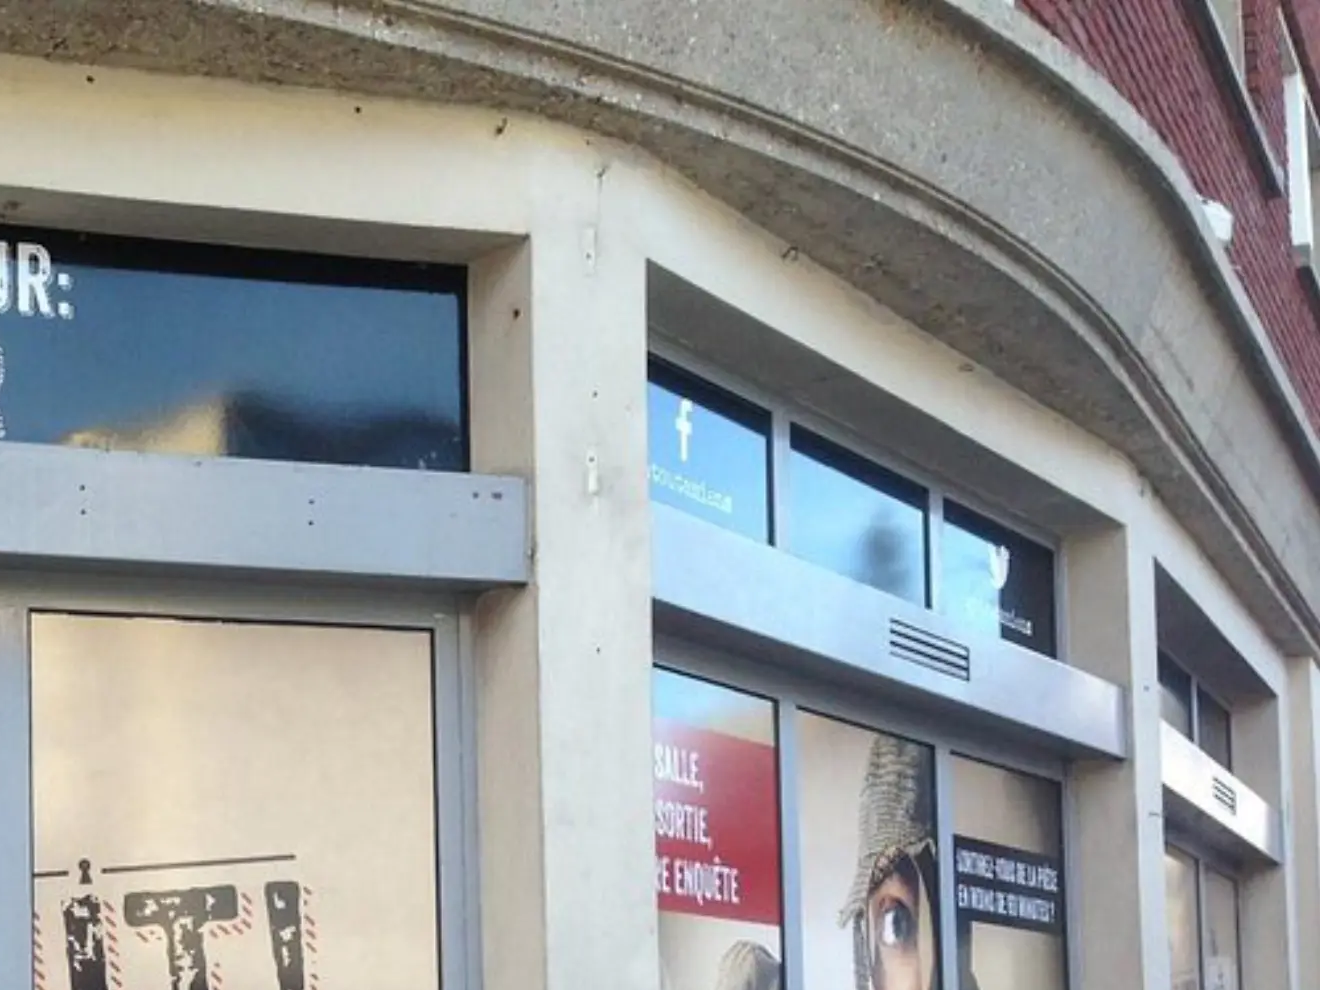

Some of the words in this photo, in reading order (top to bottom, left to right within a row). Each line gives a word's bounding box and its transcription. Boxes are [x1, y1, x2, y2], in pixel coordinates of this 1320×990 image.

[654, 743, 704, 793] SALLE,
[654, 799, 712, 849] SORTIE,
[673, 855, 740, 906] ENQUÊTE
